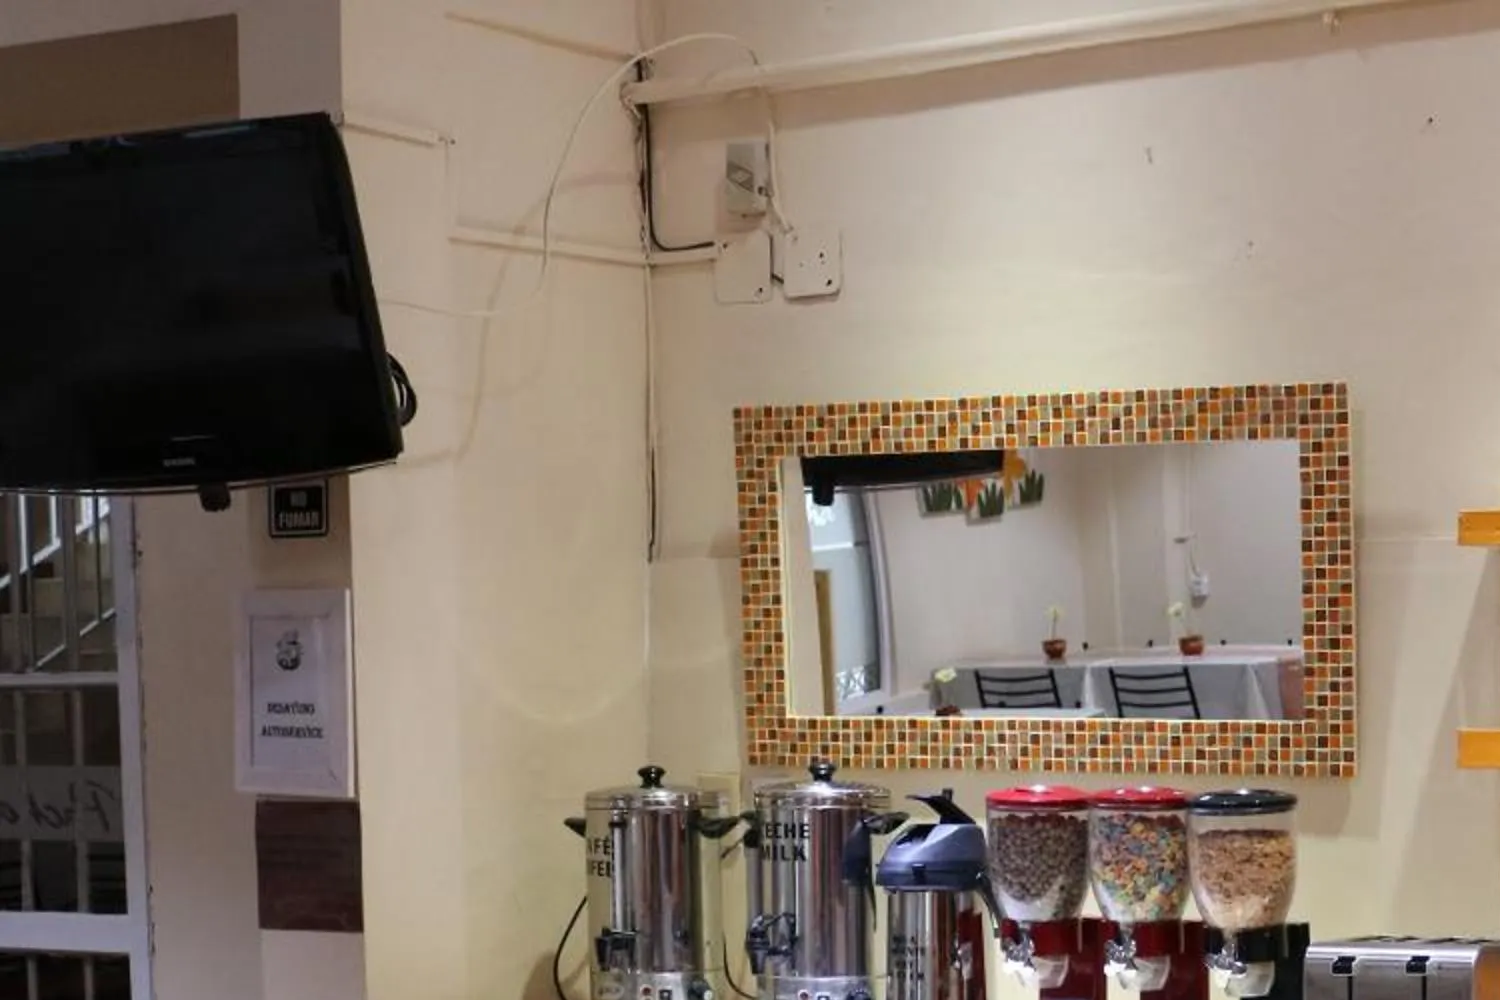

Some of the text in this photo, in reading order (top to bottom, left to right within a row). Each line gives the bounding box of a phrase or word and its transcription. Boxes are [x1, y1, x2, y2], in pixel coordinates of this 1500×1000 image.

[279, 511, 319, 528] FUMAR
[764, 823, 810, 838] ECHE
[761, 845, 806, 860] MILK
